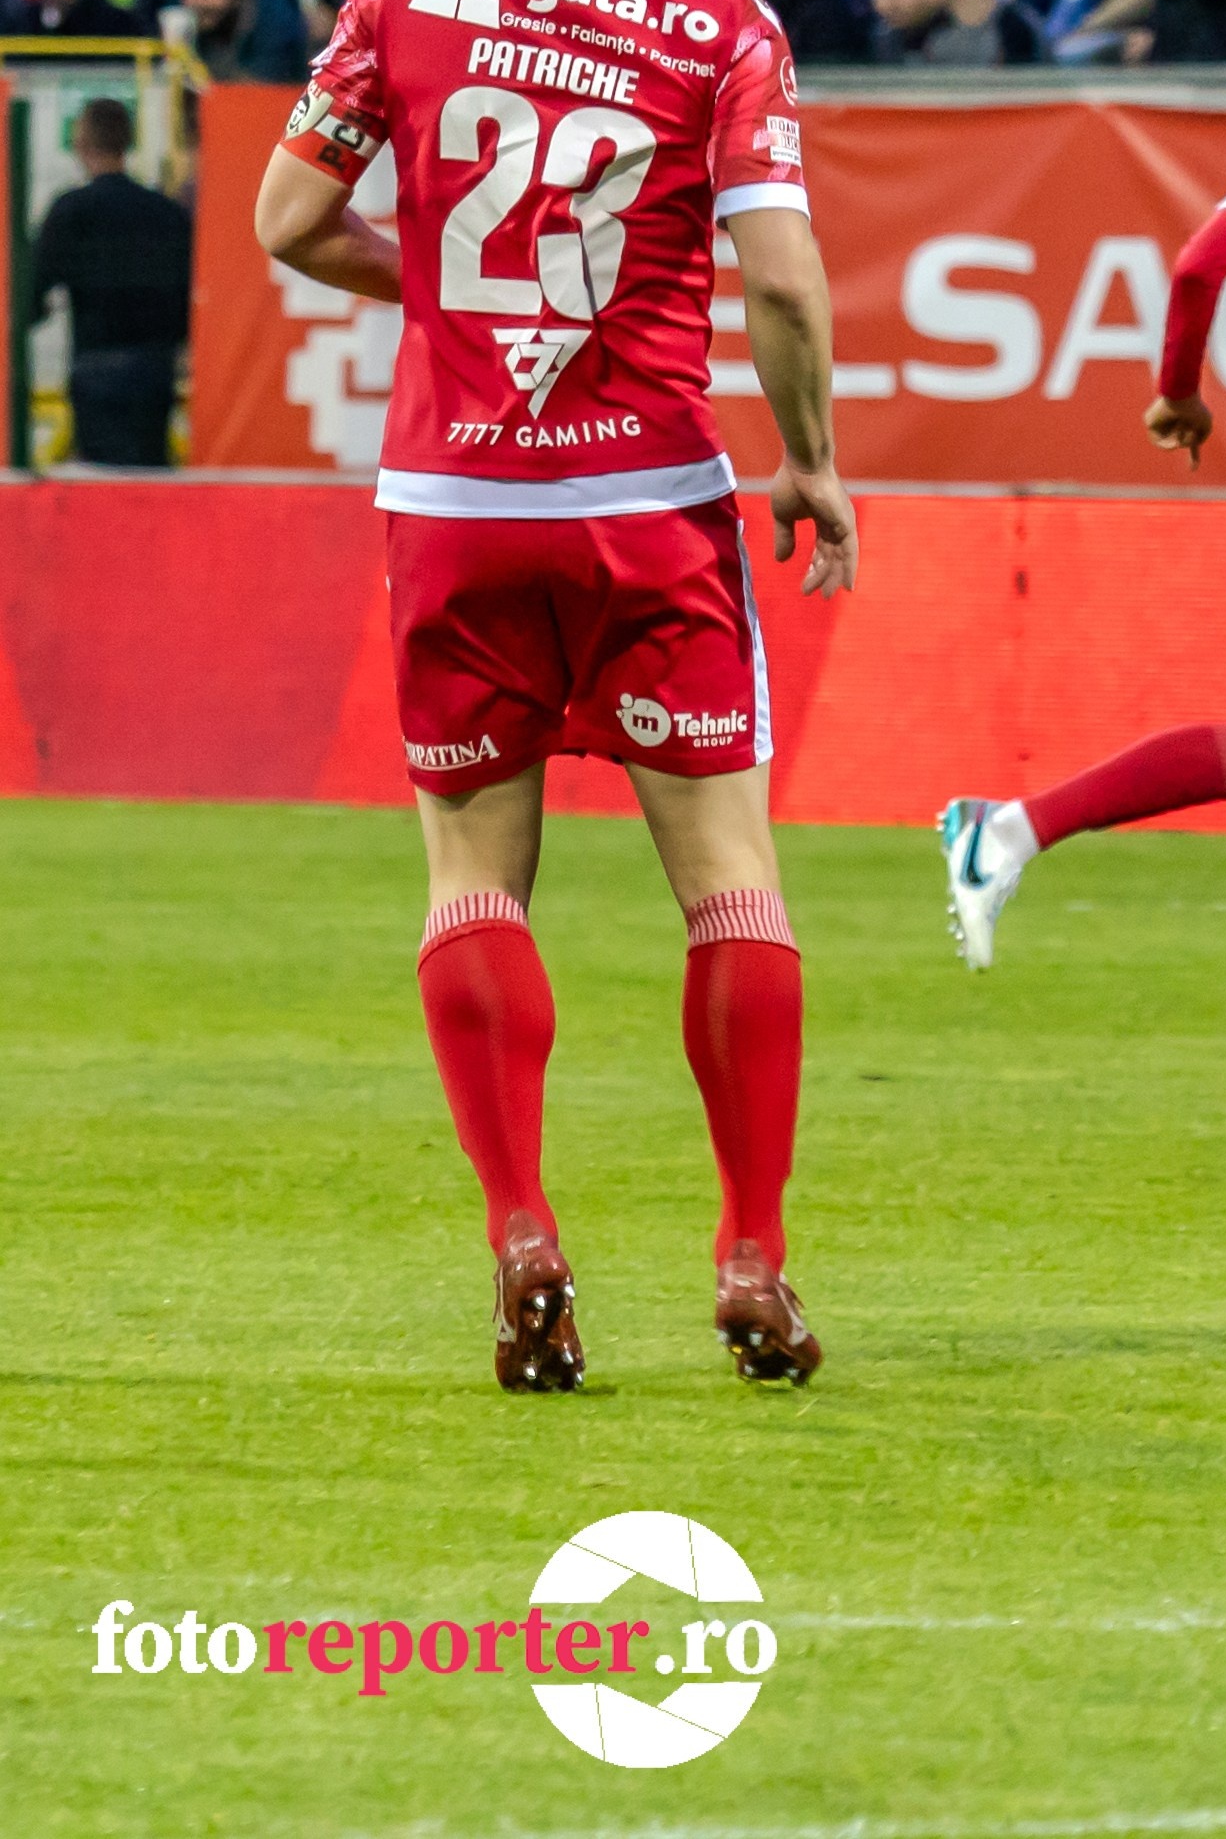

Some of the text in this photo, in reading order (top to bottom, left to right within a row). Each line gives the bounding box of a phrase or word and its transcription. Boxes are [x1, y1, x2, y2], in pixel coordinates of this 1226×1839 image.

[467, 37, 640, 105] PATRICHE
[650, 48, 716, 78] Parchet
[439, 85, 657, 321] 23
[447, 415, 642, 449] 7777 GAMING
[674, 709, 748, 737] Tehnic
[693, 735, 734, 749] GROUP
